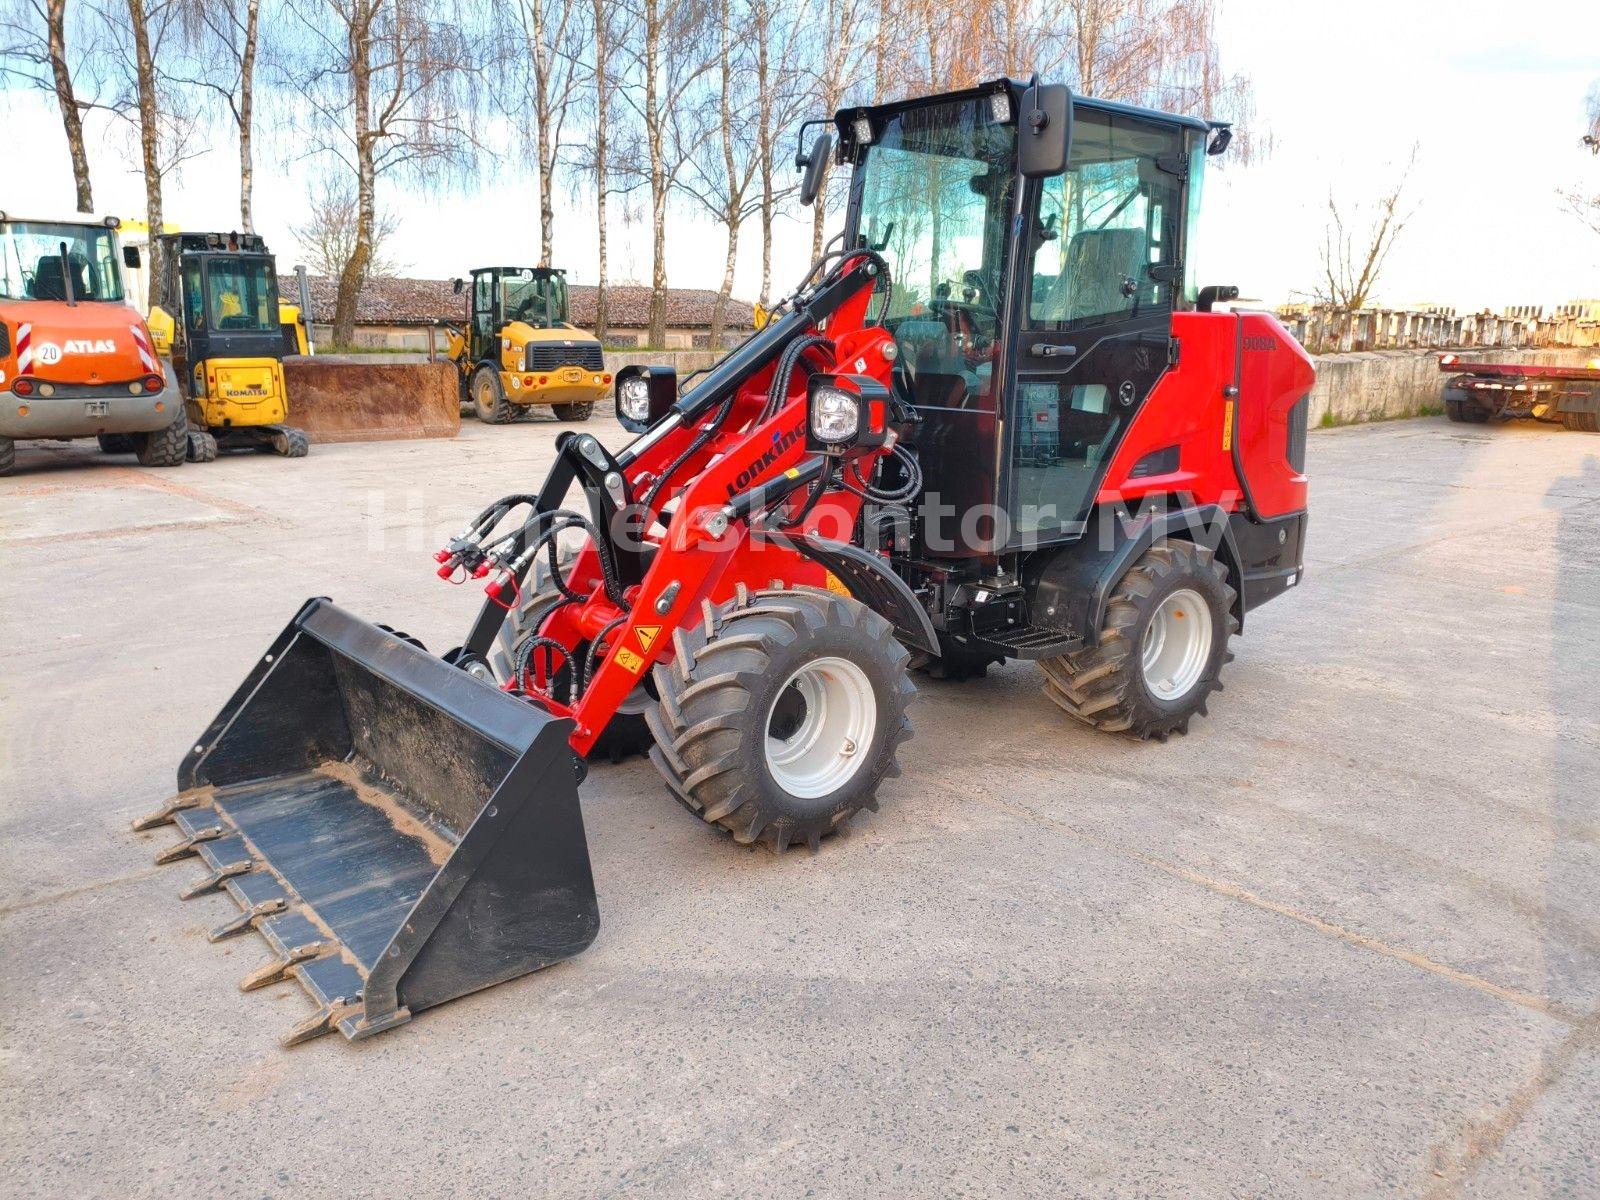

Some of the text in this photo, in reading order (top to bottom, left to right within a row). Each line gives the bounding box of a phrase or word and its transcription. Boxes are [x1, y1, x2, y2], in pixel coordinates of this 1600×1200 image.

[42, 346, 57, 360] 20
[63, 339, 116, 354] ATLAS
[226, 389, 268, 397] KOMATSU
